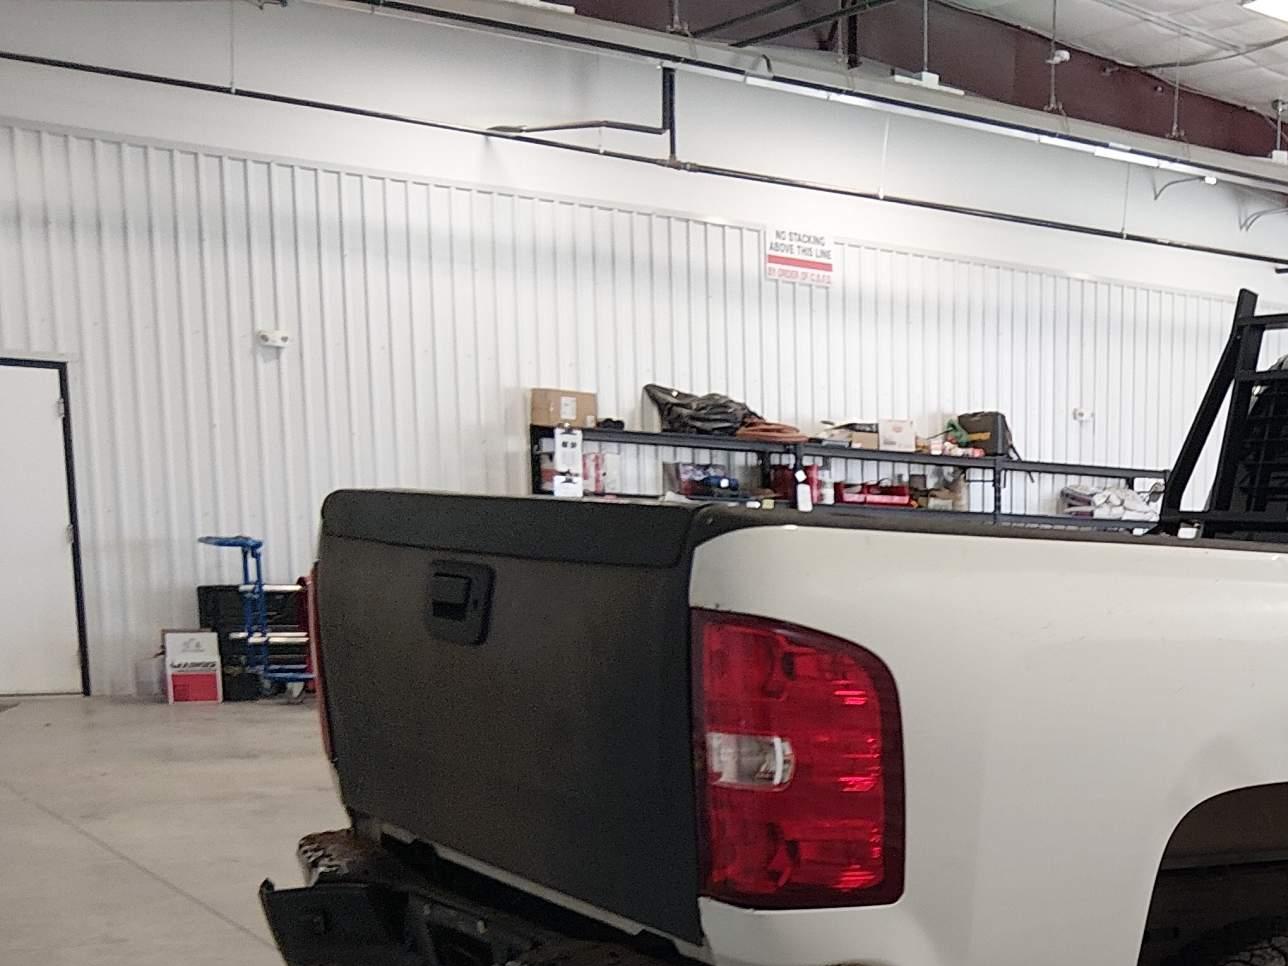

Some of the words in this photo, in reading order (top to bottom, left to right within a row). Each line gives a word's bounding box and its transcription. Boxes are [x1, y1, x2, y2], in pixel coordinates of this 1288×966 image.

[776, 230, 786, 241] NO
[789, 231, 825, 247] STACKING
[769, 241, 794, 255] ABOVE
[797, 244, 813, 257] THIS
[815, 247, 832, 260] LINE
